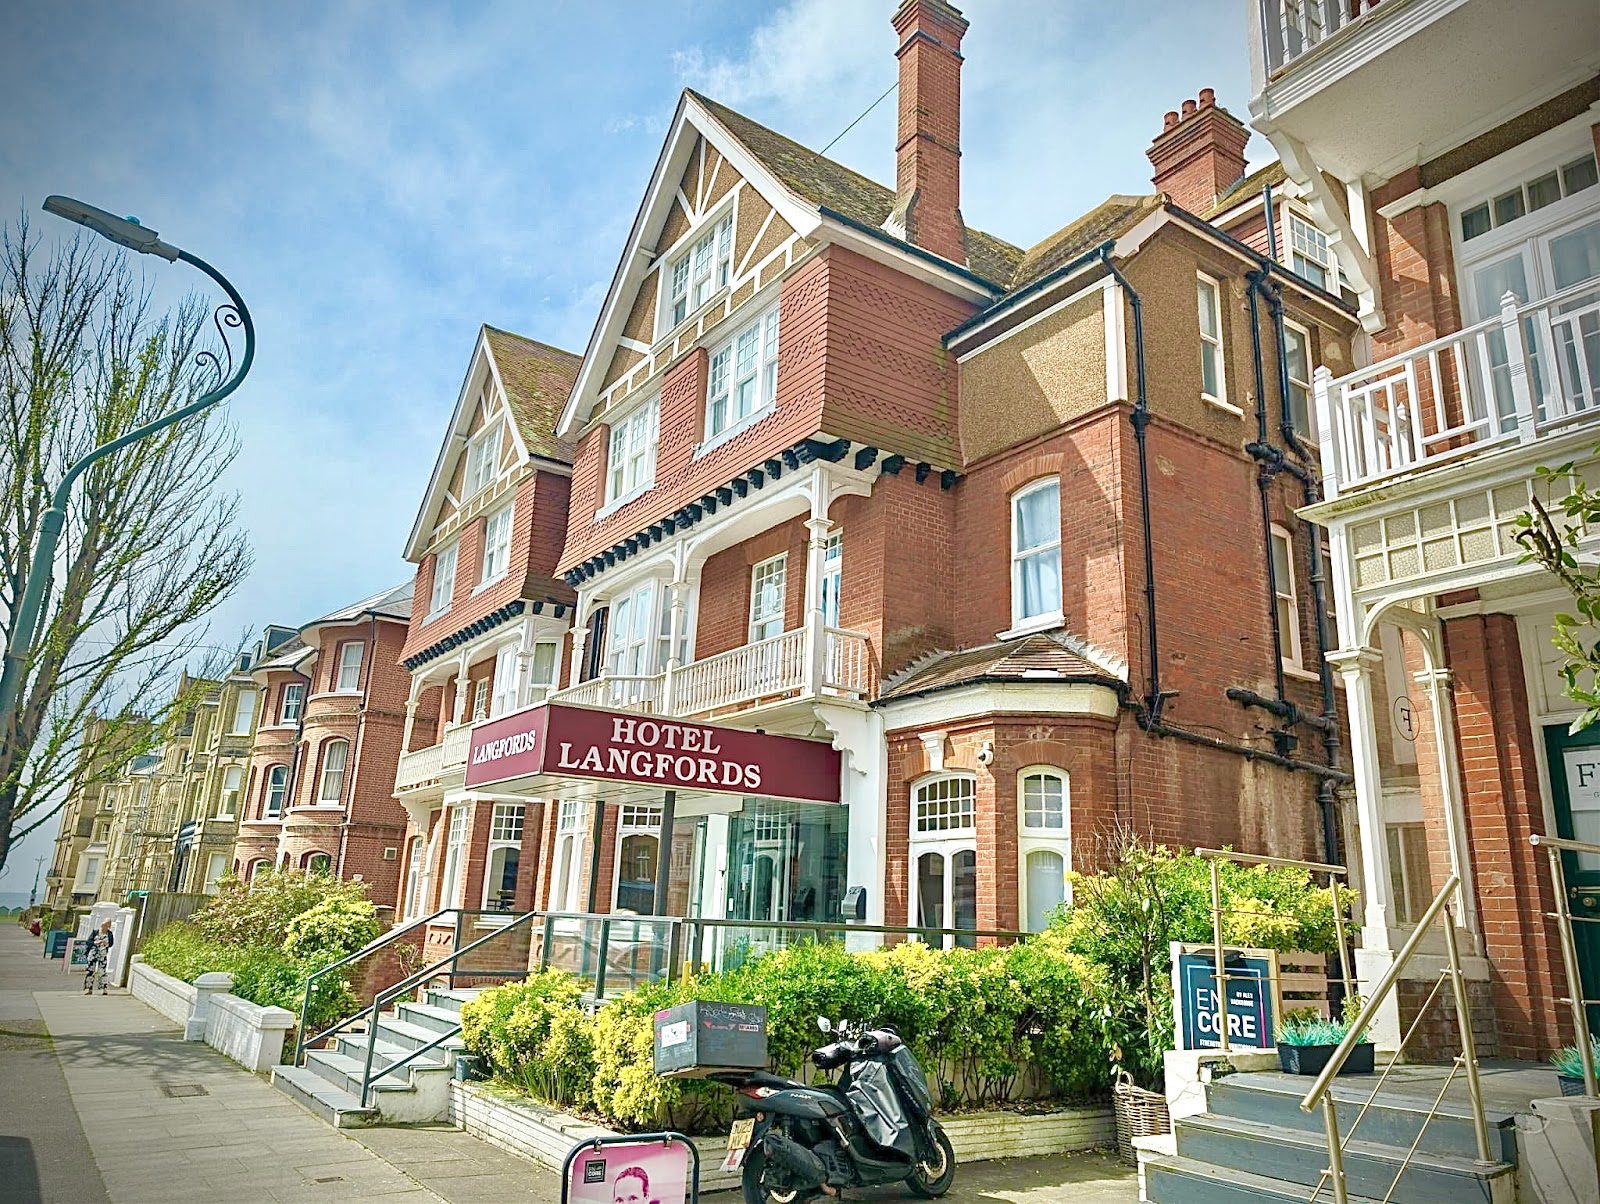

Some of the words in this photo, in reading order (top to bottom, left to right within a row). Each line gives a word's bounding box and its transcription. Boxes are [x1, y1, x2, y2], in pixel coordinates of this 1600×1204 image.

[472, 729, 536, 766] LANGFORDS
[611, 717, 721, 755] HOTEL
[557, 742, 762, 789] LANGFORDS
[1576, 762, 1600, 788] F
[1197, 1011, 1257, 1039] CORE
